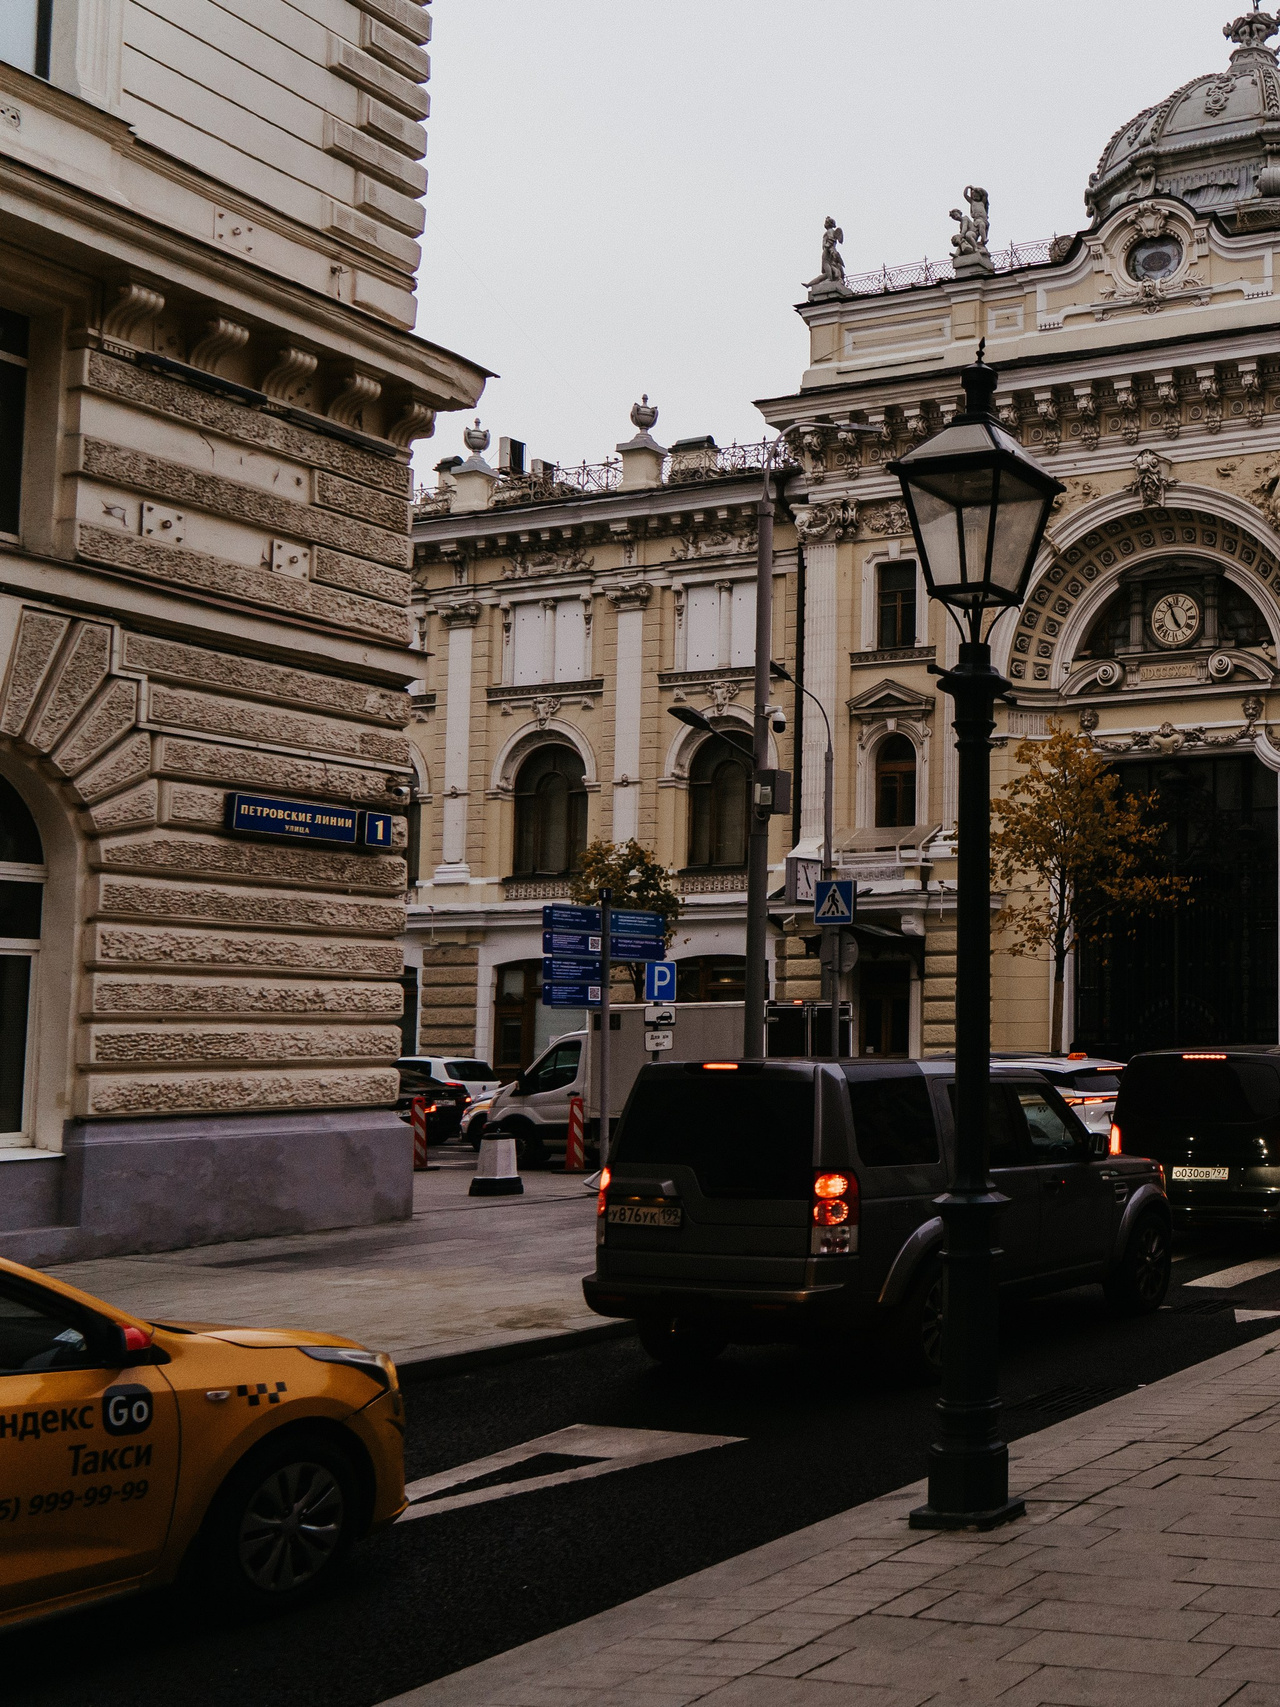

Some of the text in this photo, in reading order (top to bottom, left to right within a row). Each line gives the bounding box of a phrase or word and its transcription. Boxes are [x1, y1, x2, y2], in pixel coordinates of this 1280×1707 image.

[240, 804, 353, 829] ПЕТРОВСКИЕ ЛИНИИ
[284, 824, 310, 834] УЛИЦА
[375, 820, 385, 841] 1
[654, 966, 671, 997] P
[1212, 1168, 1226, 1176] 797
[611, 1206, 679, 1224] У876УК 199
[108, 1395, 149, 1426] Go
[67, 1443, 153, 1477] Такси
[27, 1479, 149, 1516] 999-99-99
